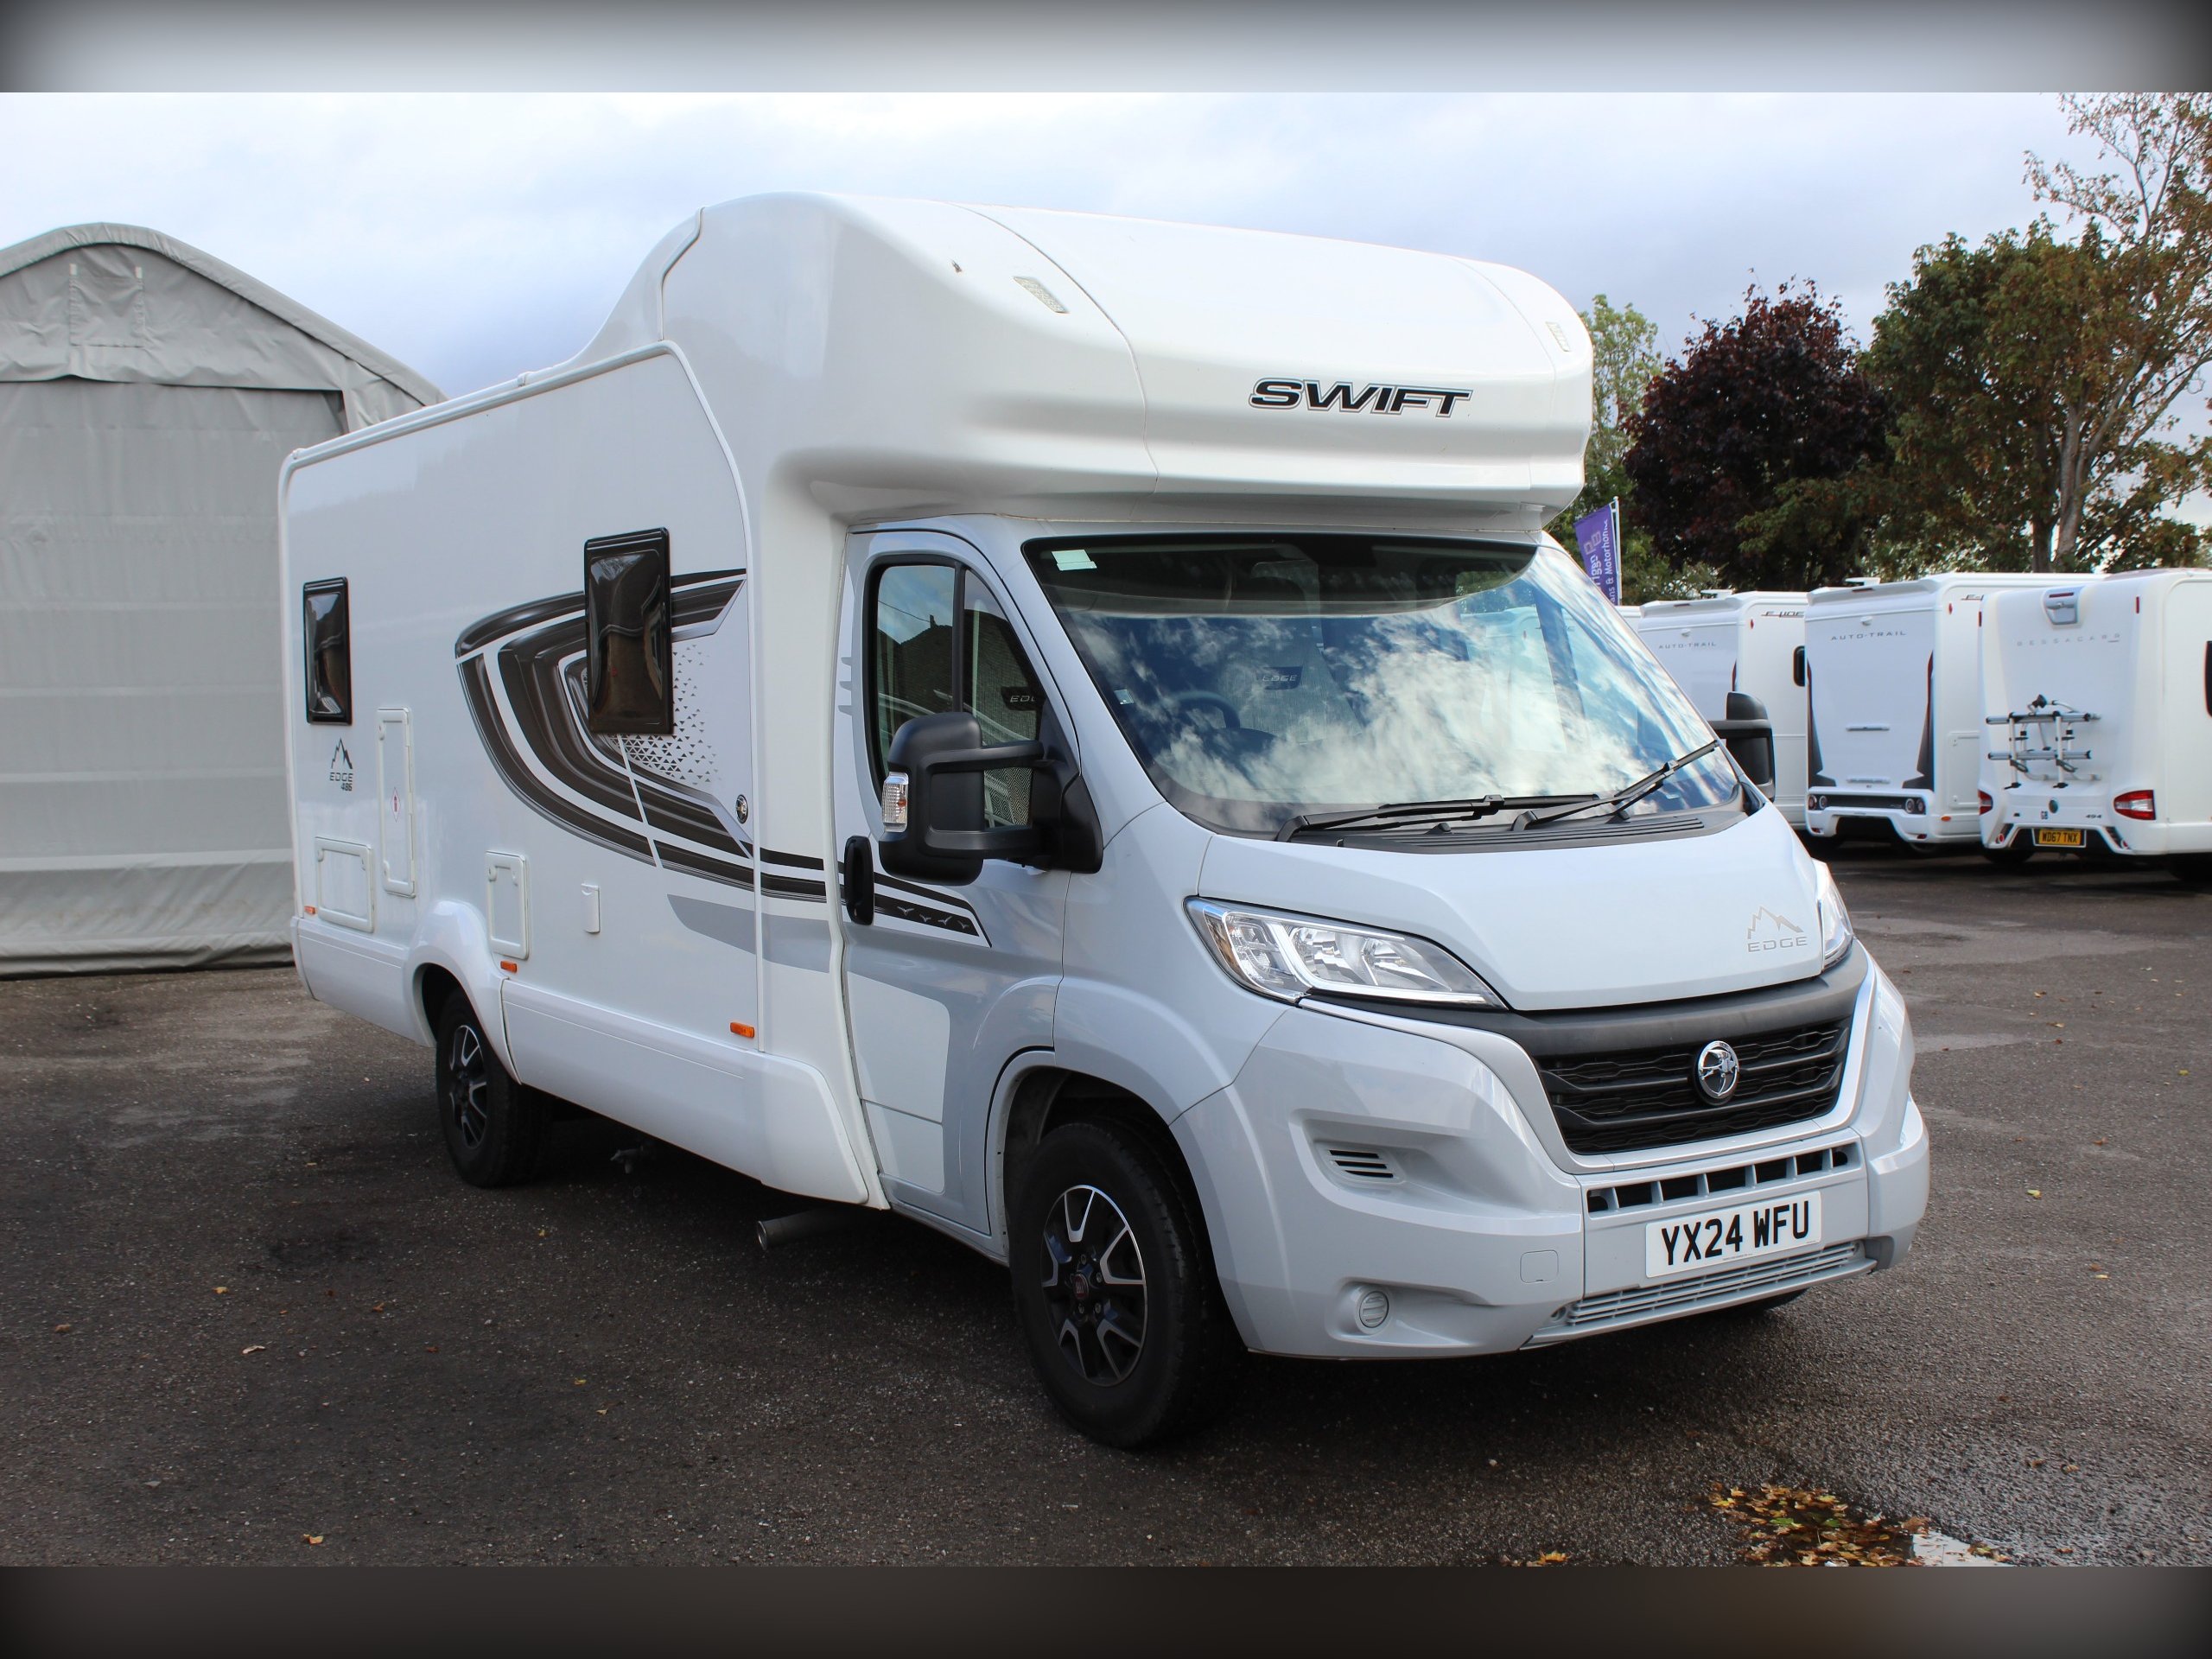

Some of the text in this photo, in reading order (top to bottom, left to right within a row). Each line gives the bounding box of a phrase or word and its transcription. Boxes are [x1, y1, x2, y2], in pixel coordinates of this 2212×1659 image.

[1249, 378, 1473, 418] SWIFT
[1831, 631, 1906, 641] AUTO-TRAIL
[329, 772, 353, 782] EDGE
[2042, 831, 2077, 842] WD67 TNX
[1747, 936, 1808, 952] EDGE
[1661, 1200, 1809, 1266] YX24 WFU
